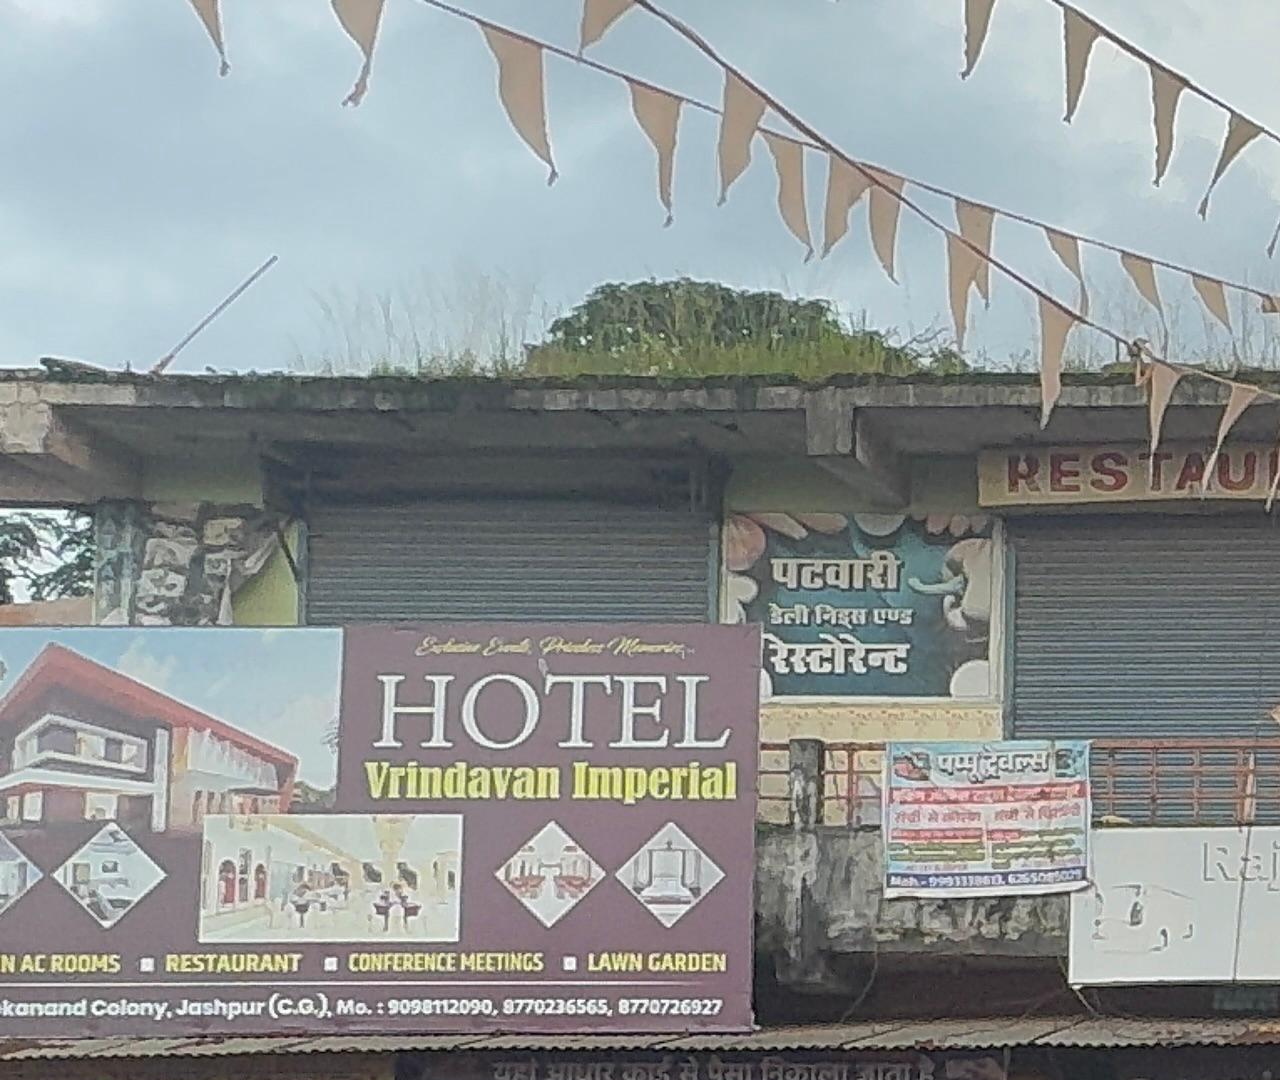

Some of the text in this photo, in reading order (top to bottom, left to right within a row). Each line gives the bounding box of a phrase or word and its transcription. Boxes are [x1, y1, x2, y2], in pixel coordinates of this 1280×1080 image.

[770, 550, 904, 590] पटवारी
[769, 603, 809, 625] डेली
[873, 606, 914, 625] एण्ड
[763, 632, 912, 674] रेस्टोरेन्ट
[371, 673, 732, 749] HOTEL
[364, 760, 738, 805] Vrindavan Imperial
[20, 953, 46, 973] AC
[51, 953, 121, 974] ROOMS
[165, 952, 303, 973] RESTAURANT
[349, 952, 457, 972] CONFERENCE
[460, 951, 545, 972] MEETINGS
[587, 951, 643, 972] LAWN
[648, 951, 727, 972] GARDEN
[0, 998, 87, 1017] kanand
[90, 998, 173, 1021] Colony,
[176, 997, 266, 1021] Jashpur
[387, 998, 499, 1017] 9098112090,
[502, 998, 613, 1017] 8770236565,
[617, 998, 724, 1017] 8770726927
